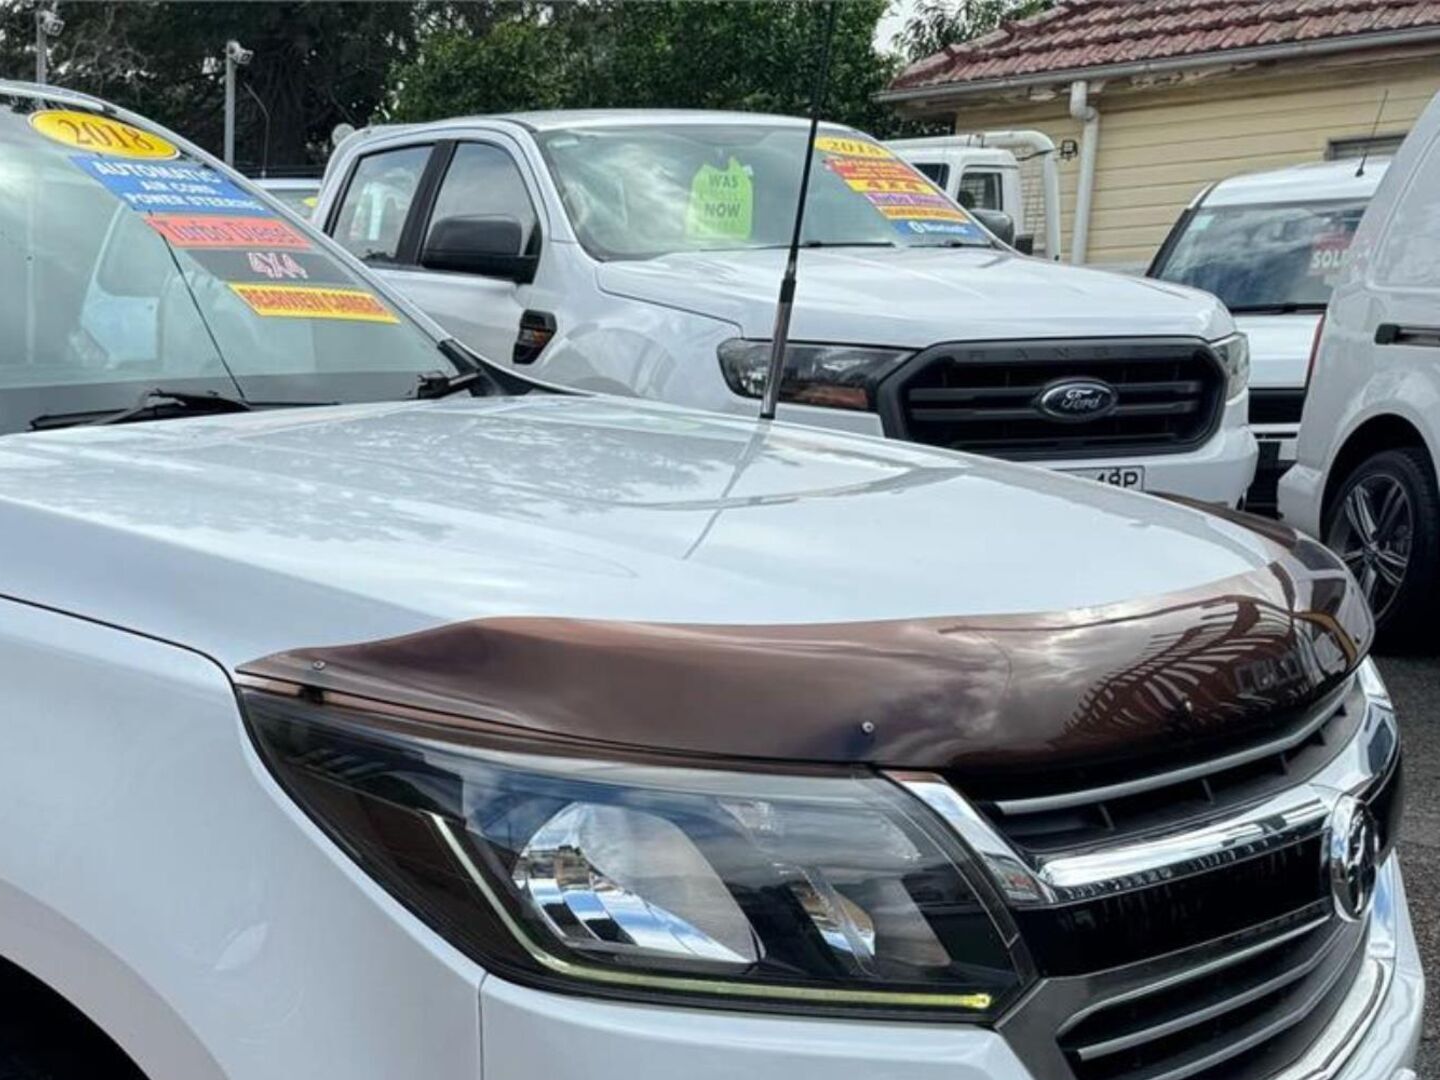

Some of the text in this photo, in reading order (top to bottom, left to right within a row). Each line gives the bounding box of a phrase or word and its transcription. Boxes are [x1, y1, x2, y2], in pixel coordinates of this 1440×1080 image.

[58, 120, 154, 151] 2018
[92, 161, 222, 184] AUTOMATIC
[704, 203, 741, 217] NOW
[1061, 388, 1104, 411] Ford
